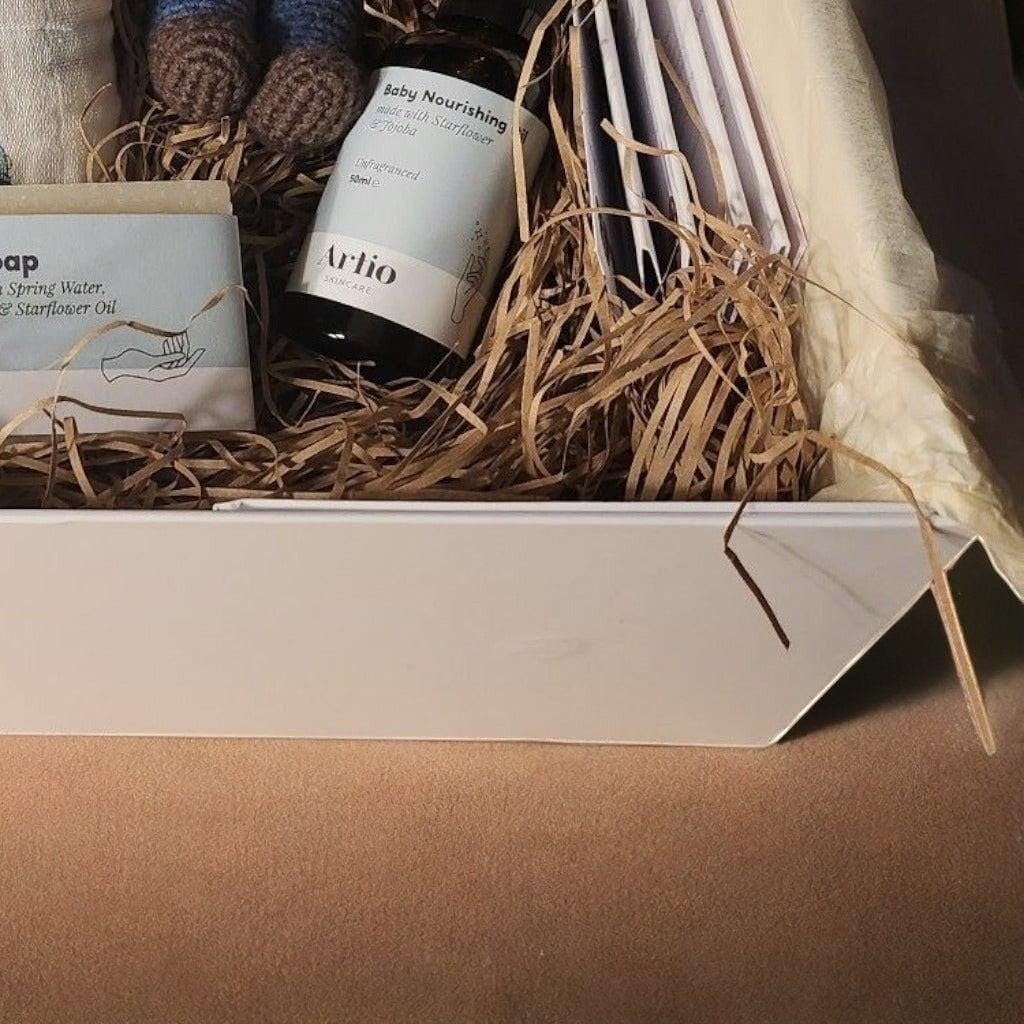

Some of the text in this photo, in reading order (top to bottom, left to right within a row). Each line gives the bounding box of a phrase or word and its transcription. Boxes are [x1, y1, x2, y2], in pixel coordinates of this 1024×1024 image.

[383, 83, 418, 103] Baby
[422, 89, 509, 135] Nourishing
[376, 103, 495, 146] made with Starflower
[379, 118, 419, 138] Jojoba
[348, 173, 372, 186] 50ml
[353, 157, 422, 182] Unfragranced
[315, 243, 397, 285] Artio
[6, 281, 57, 299] Spring
[60, 279, 106, 296] Water,
[15, 301, 91, 319] Starflower
[94, 299, 118, 315] Oil
